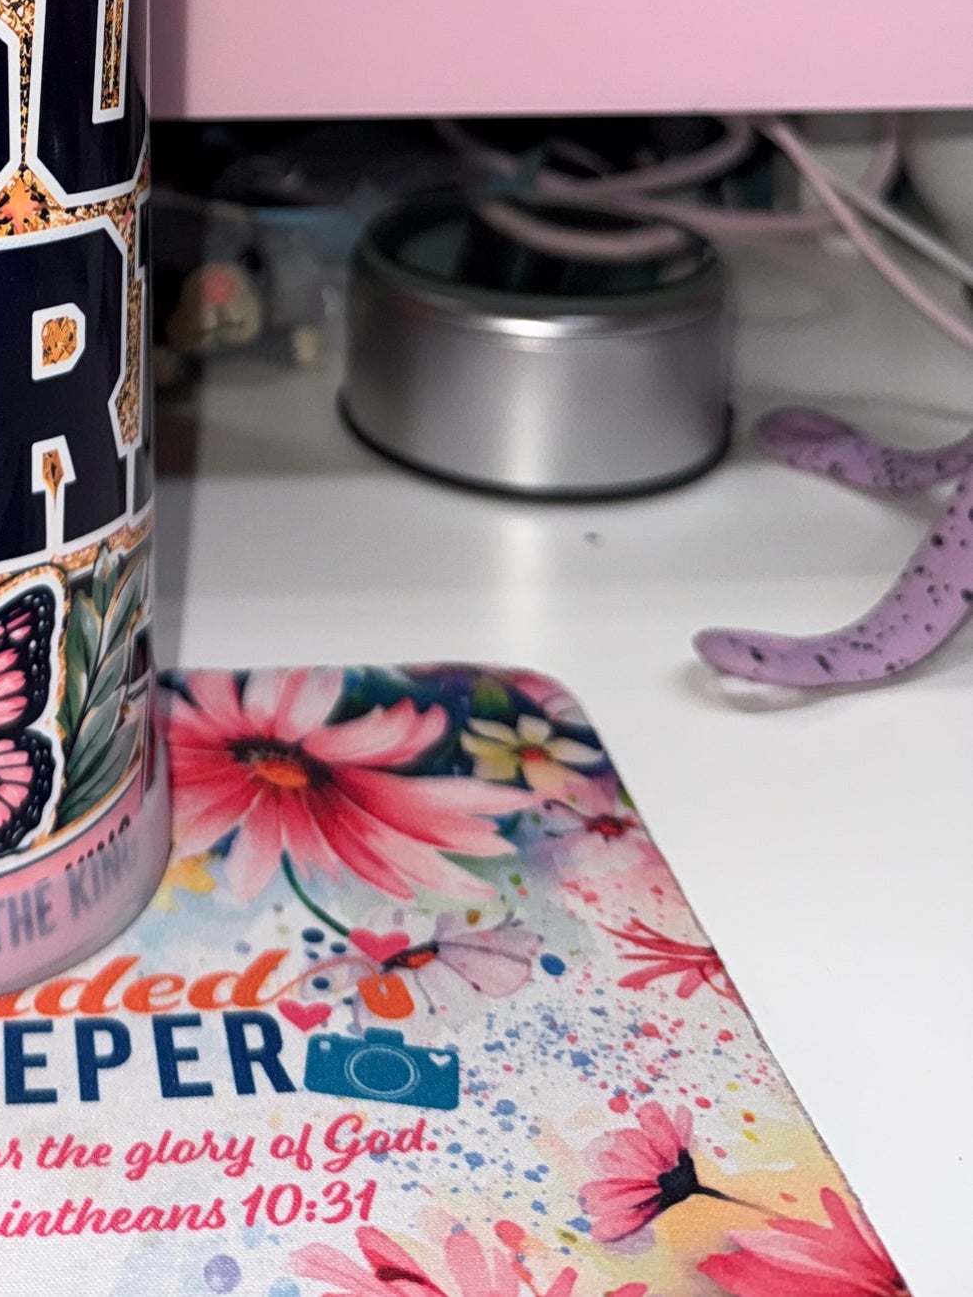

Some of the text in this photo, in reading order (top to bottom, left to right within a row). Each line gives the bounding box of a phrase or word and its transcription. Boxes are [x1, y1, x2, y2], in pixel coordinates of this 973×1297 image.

[36, 1134, 111, 1169] the
[124, 1130, 256, 1182] glory
[269, 1124, 313, 1172] of
[323, 1113, 438, 1173] God.
[239, 1180, 378, 1229] 10:31
